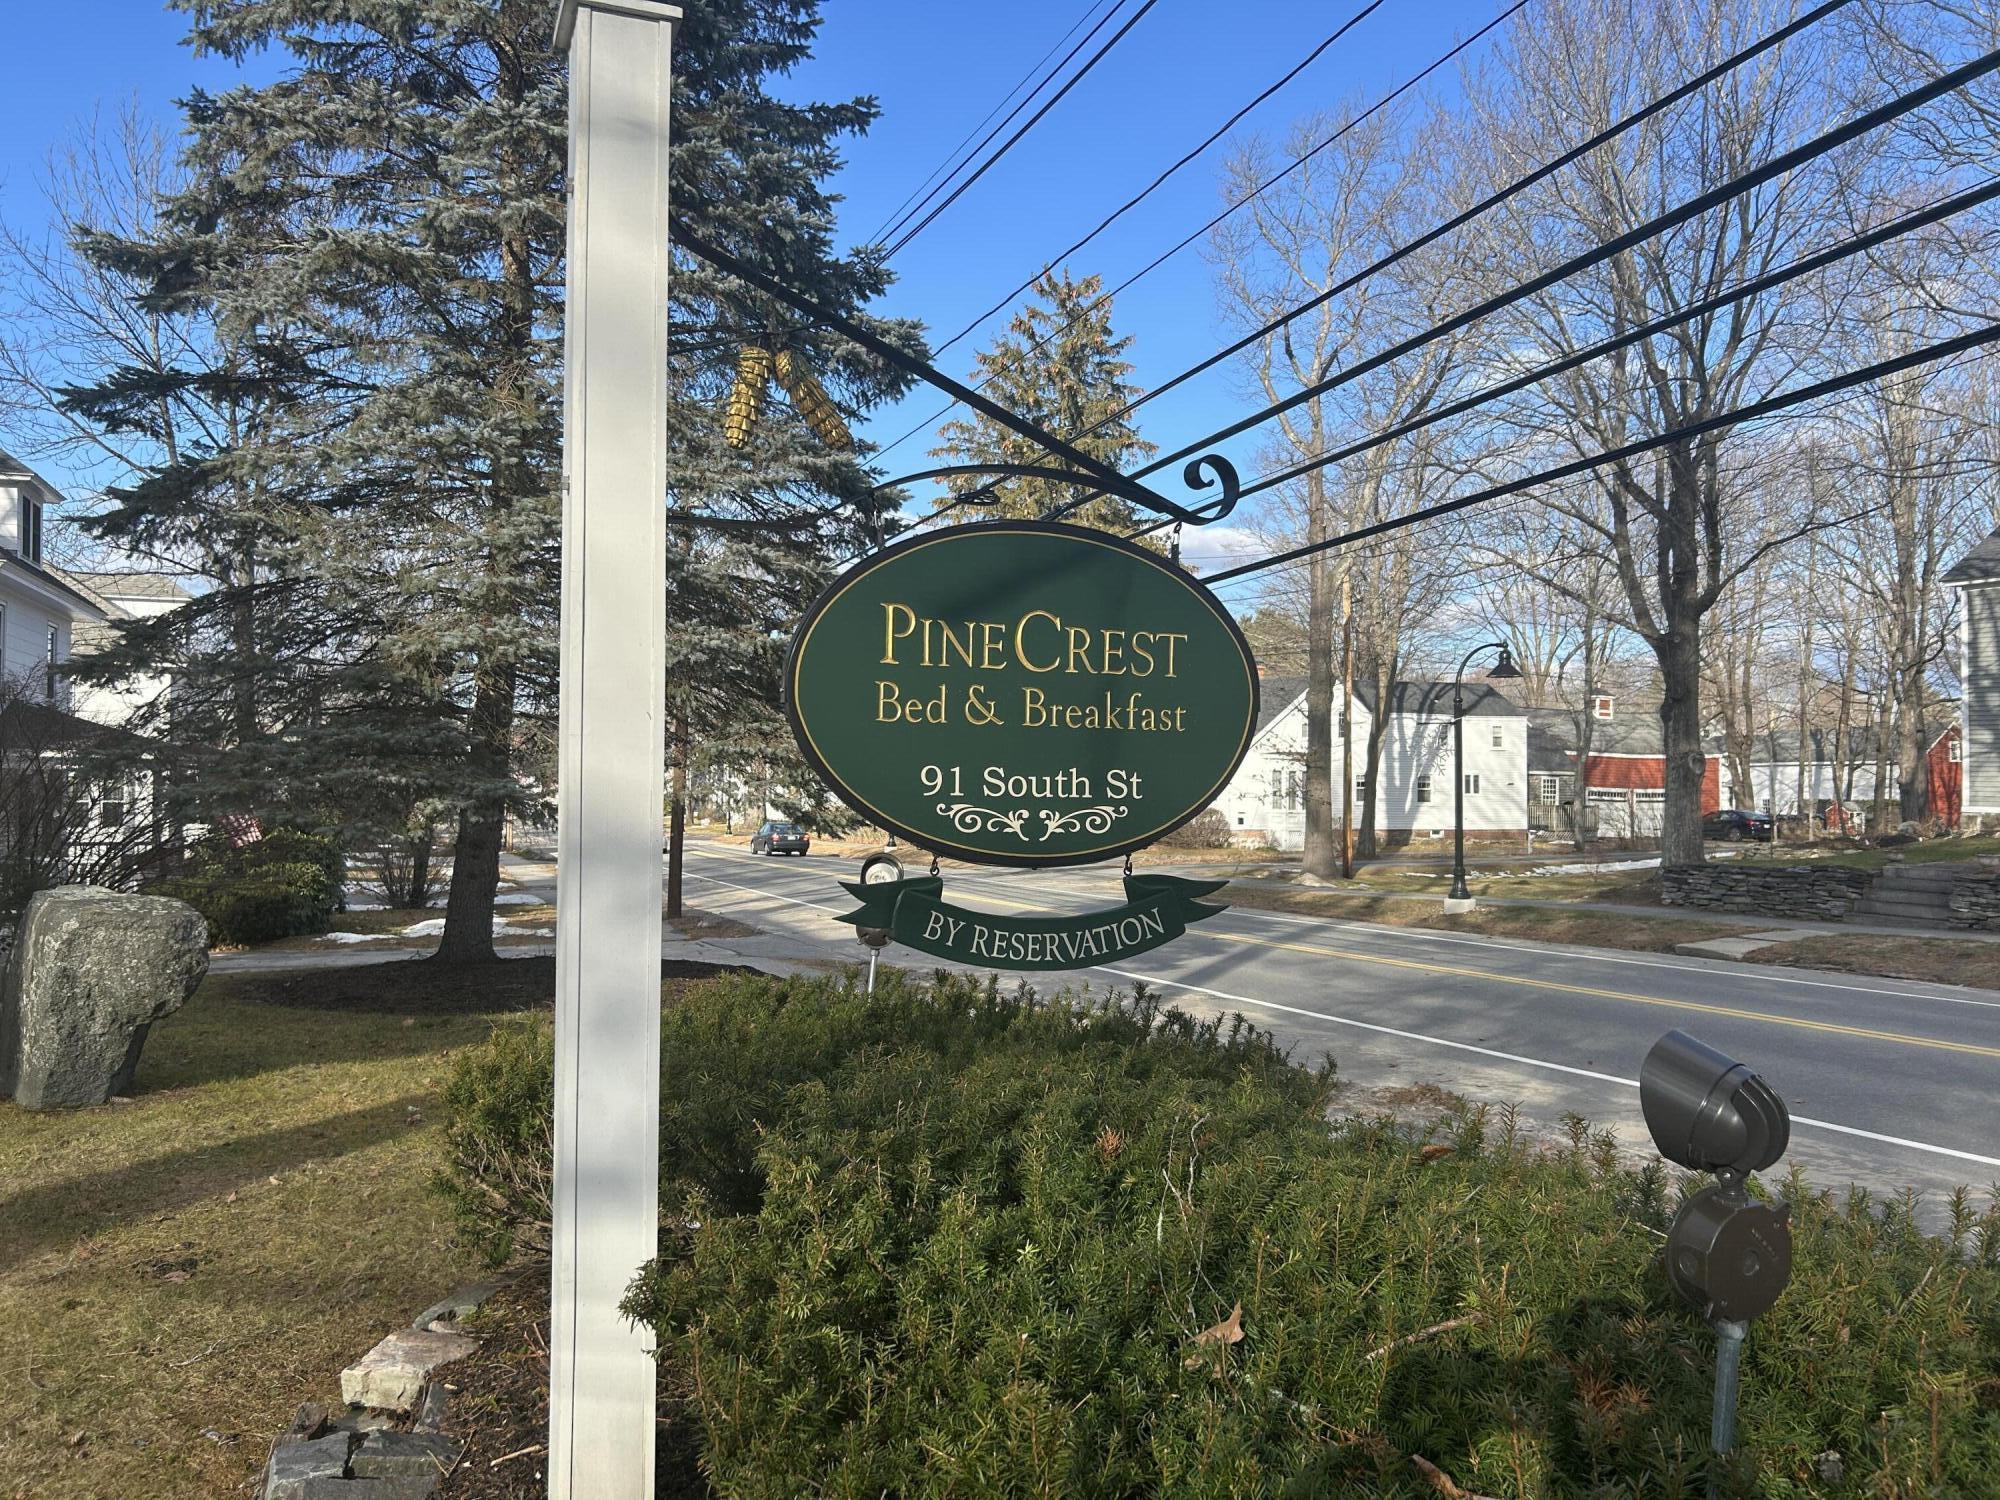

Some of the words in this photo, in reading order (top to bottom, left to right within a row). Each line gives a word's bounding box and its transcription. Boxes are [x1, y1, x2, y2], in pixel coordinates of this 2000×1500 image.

[879, 602, 1188, 678] PINECREST
[875, 680, 947, 724] Bed
[965, 684, 1004, 725] &
[1022, 686, 1187, 732] Breakfast
[920, 765, 965, 797] 91
[983, 766, 1092, 798] South
[1106, 769, 1143, 800] St
[923, 911, 966, 947] BY
[970, 908, 1165, 962] RESERVATION
